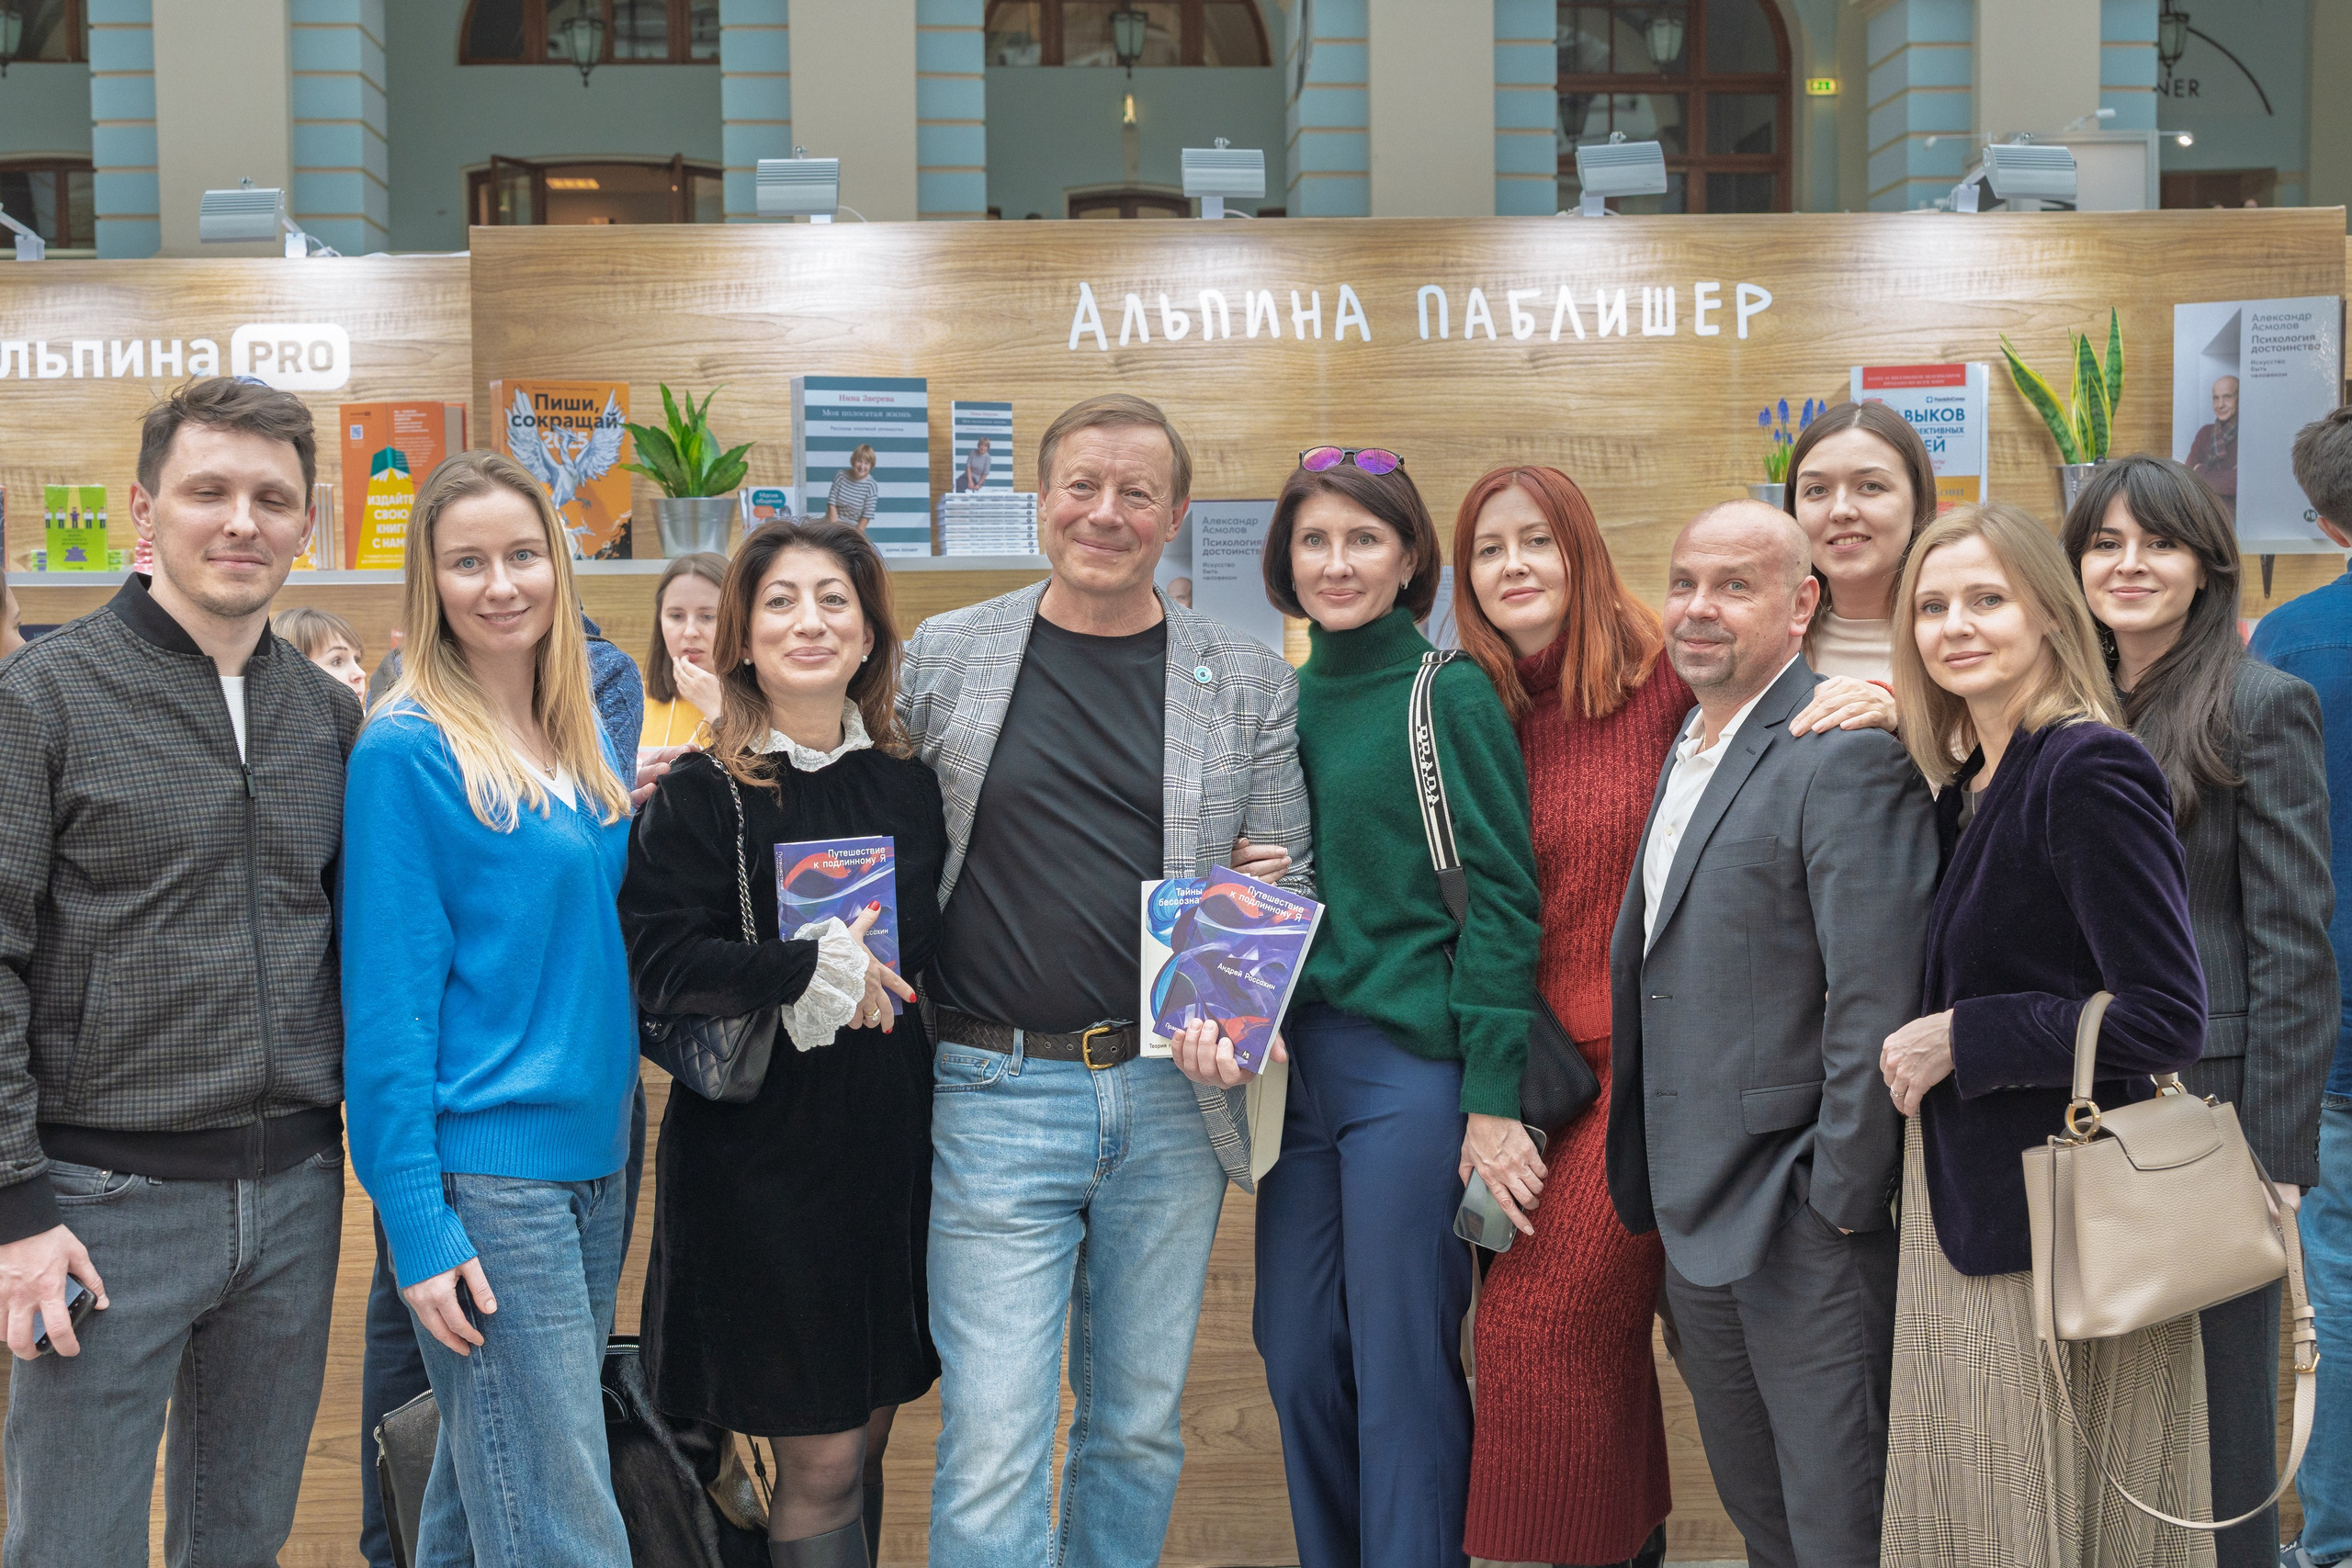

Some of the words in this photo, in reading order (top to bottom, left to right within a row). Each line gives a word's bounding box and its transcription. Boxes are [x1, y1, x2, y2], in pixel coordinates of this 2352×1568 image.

[1069, 282, 1372, 351] АЛЬПИНА
[1417, 281, 1773, 342] ПАБЛИШЕР
[2251, 312, 2312, 322] Александр
[2251, 322, 2300, 332] Асмолов
[2251, 334, 2316, 344] Психология
[247, 340, 334, 374] PRO
[534, 393, 600, 413] Пиши,
[839, 394, 860, 402] Нина
[862, 394, 895, 404] Зверева
[821, 409, 840, 417] Моя
[841, 410, 883, 418] полосатая
[1896, 408, 1966, 423] ВЫКОВ
[511, 412, 618, 433] сокращай
[368, 492, 414, 507] ИЗДАЙТЕ
[373, 509, 409, 521] СВОЮ
[1202, 516, 1259, 525] Александр
[376, 524, 407, 534] КНИГ
[1202, 525, 1248, 535] Асмолов
[371, 537, 381, 549] С
[382, 537, 406, 548] НАМ
[1202, 537, 1262, 547] Психология
[1202, 547, 1262, 557] достоинств
[1202, 561, 1236, 570] Искусство
[1417, 723, 1440, 808] PRADA
[828, 847, 886, 860] Путешествие
[822, 856, 876, 869] подлинному
[879, 853, 887, 863] Я
[1176, 887, 1203, 897] Тайны
[1247, 885, 1305, 914] Путешествие
[1238, 894, 1292, 920] подлинному
[1294, 912, 1303, 923] Я
[864, 928, 889, 936] ссохин
[1216, 962, 1243, 978] Андрей
[1244, 972, 1276, 990] Россохин
